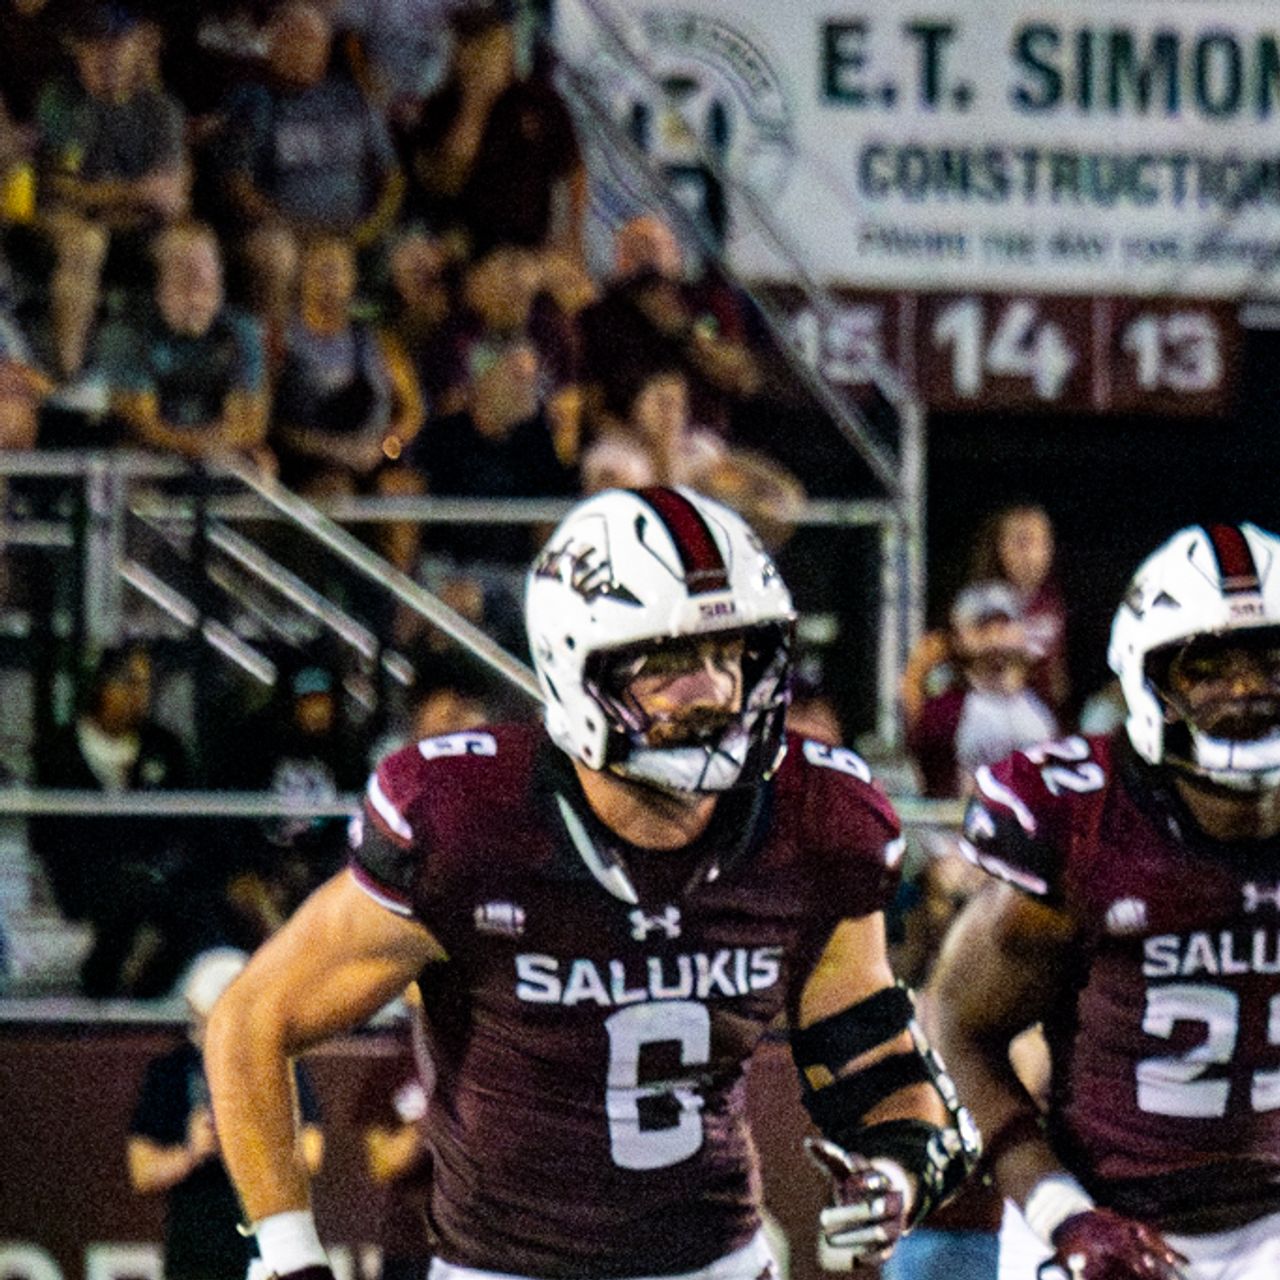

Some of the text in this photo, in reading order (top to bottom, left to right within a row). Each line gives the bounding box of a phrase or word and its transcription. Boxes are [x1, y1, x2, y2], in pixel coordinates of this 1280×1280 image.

[815, 18, 973, 112] E.T.
[932, 298, 1078, 402] 14
[1119, 308, 1223, 394] 13
[514, 945, 787, 1007] SALUKIS
[604, 999, 711, 1171] 6
